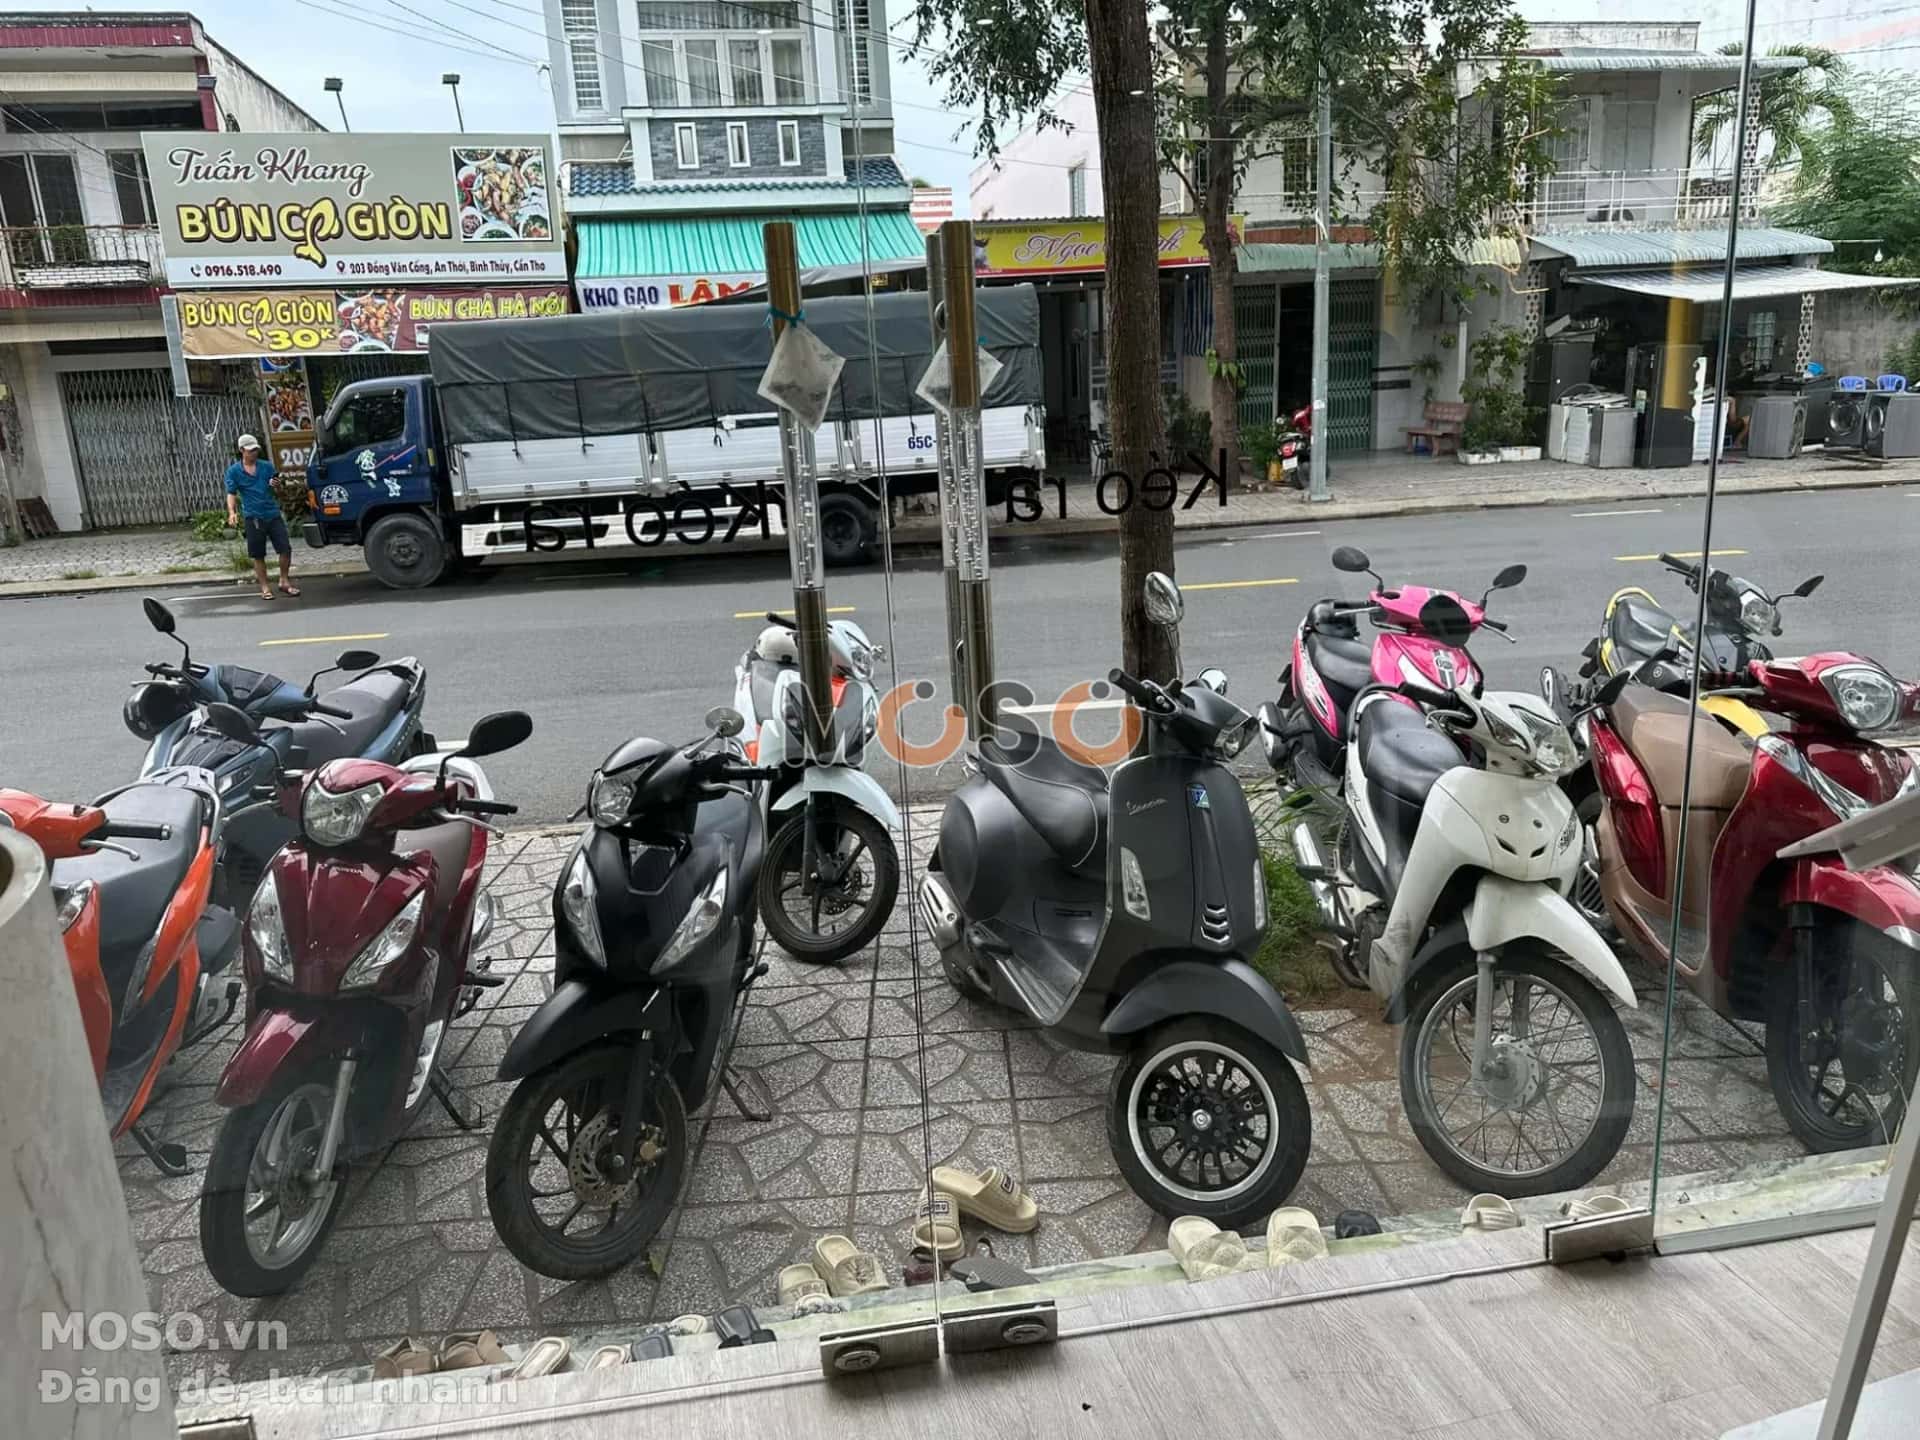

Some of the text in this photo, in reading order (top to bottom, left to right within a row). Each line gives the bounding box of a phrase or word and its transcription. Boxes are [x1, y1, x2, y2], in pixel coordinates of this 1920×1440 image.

[168, 147, 370, 198] Tuấn Khang
[176, 197, 277, 243] BÚN
[345, 196, 452, 241] GIÒN
[204, 264, 282, 277] 0916.518.490
[183, 298, 235, 327] BÚN
[275, 296, 334, 324] GIÒN
[583, 286, 618, 308] KHO
[624, 286, 660, 309] GẠO
